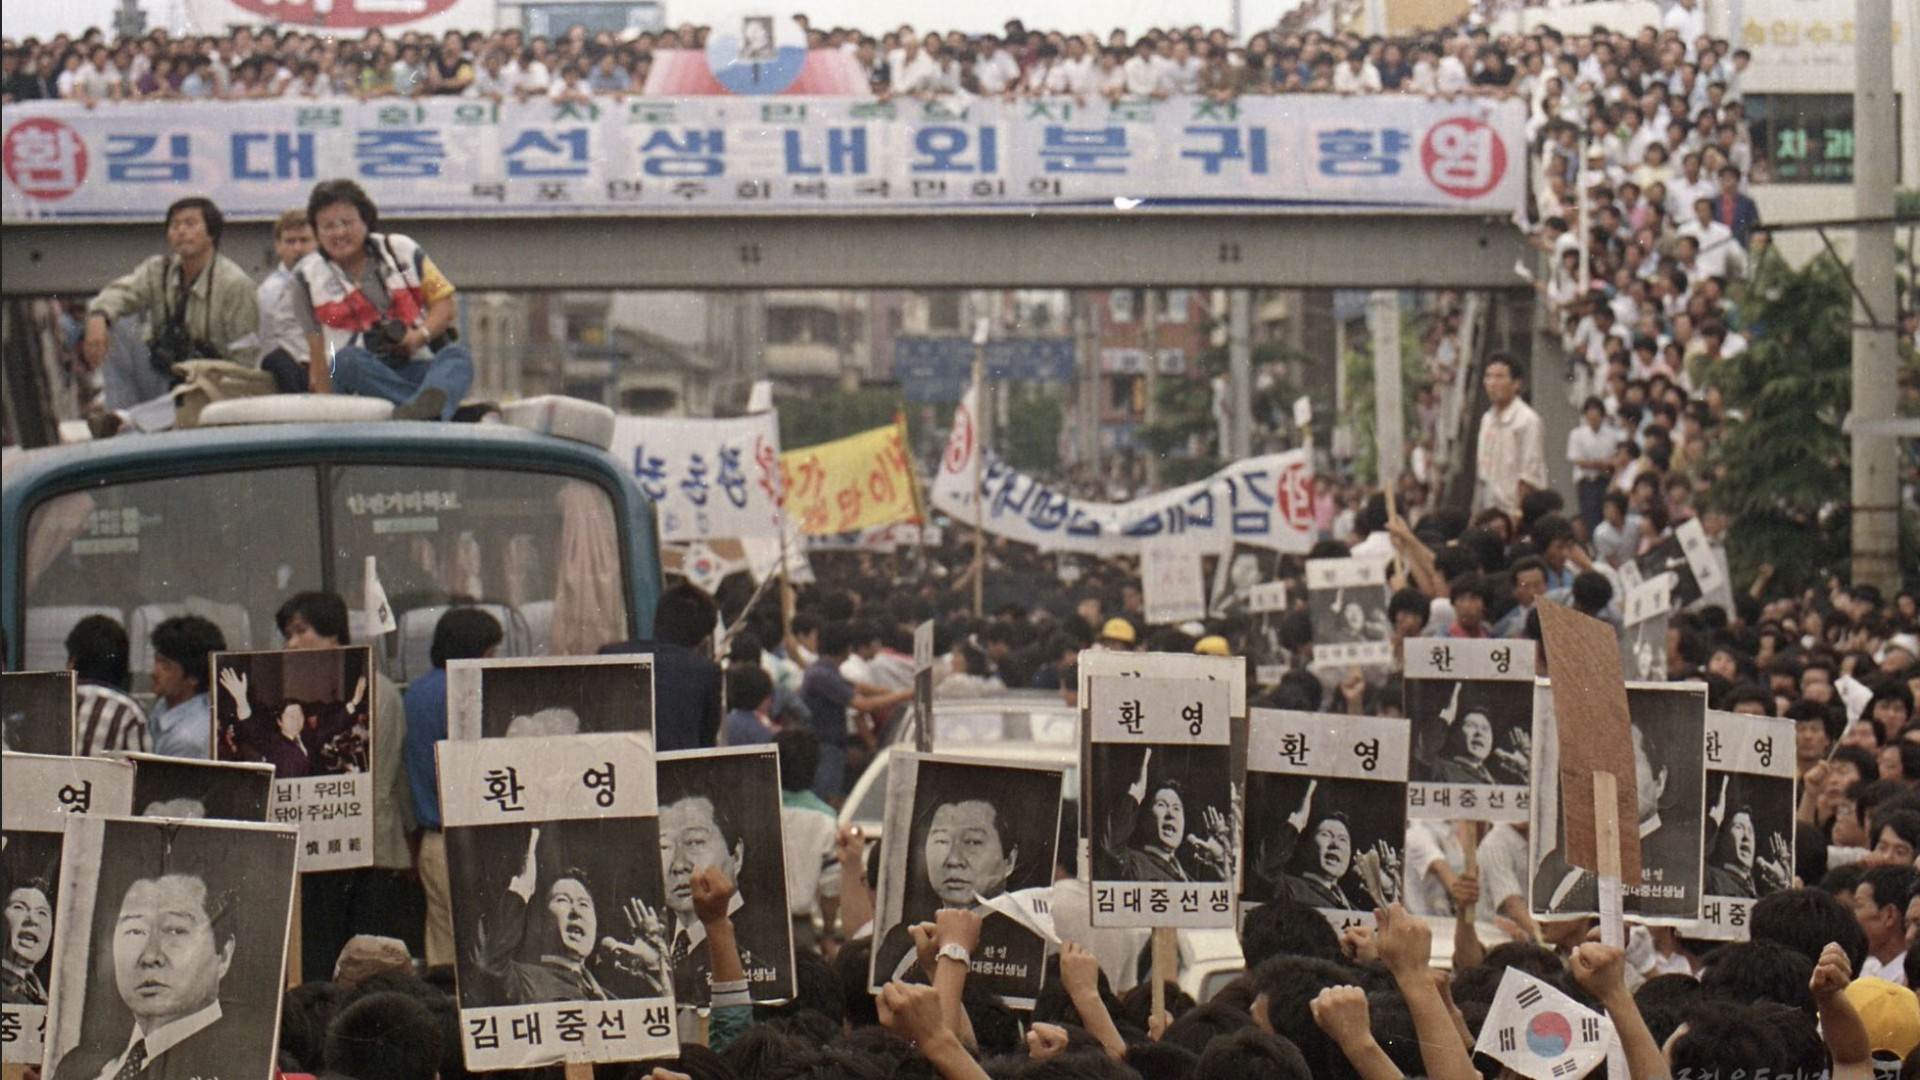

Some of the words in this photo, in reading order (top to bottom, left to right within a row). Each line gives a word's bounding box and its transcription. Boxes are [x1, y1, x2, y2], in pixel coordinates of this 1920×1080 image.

[1429, 645, 1511, 673] 환영
[1117, 699, 1204, 736] 환영
[1278, 732, 1380, 772] 환영
[314, 780, 356, 799] 우리의
[483, 762, 616, 812] 환영
[307, 802, 362, 821] 주십시오
[1097, 887, 1230, 914] 김대중선생
[984, 945, 1007, 958] 환영
[469, 1006, 671, 1050] 김대중선생
